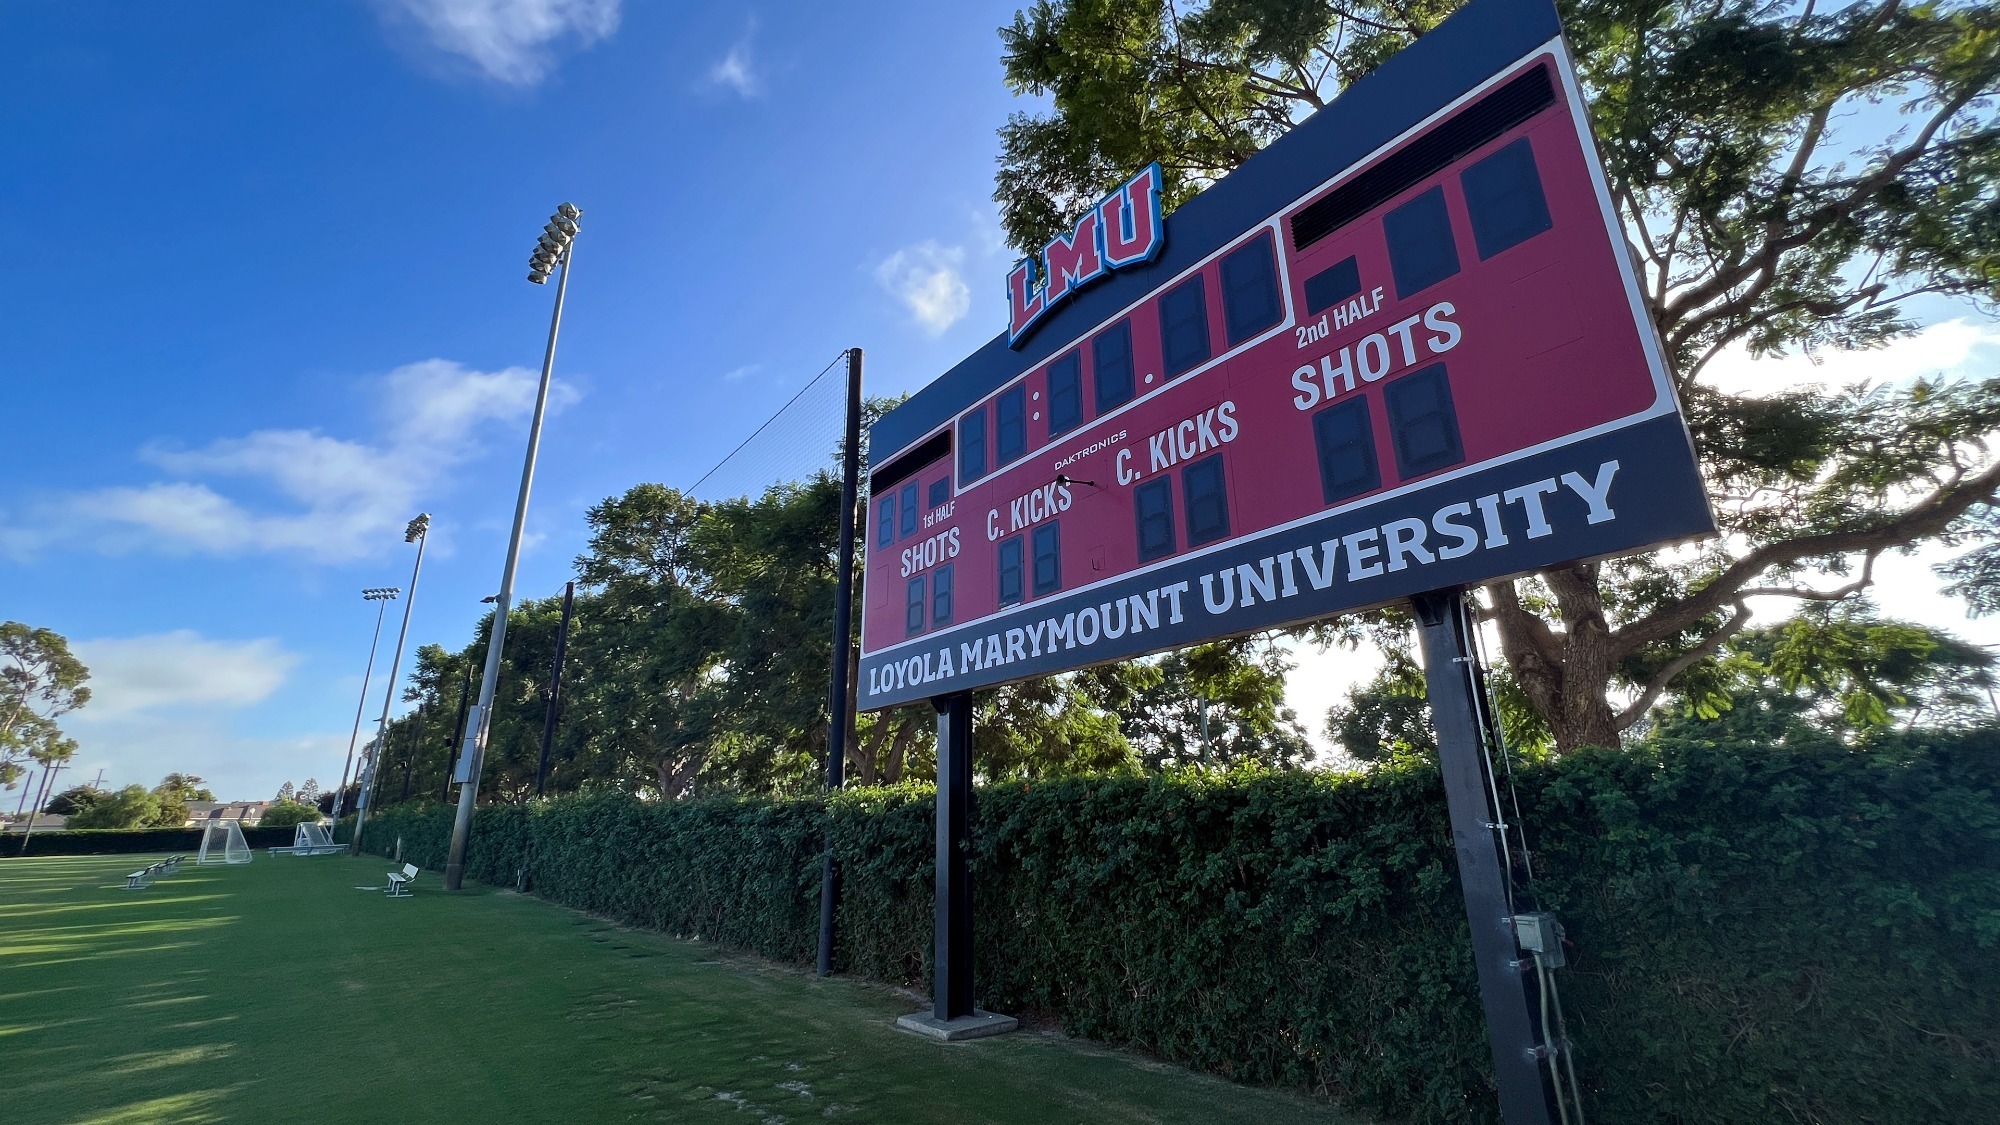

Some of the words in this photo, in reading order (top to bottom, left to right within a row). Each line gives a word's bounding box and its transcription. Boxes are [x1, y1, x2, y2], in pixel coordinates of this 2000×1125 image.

[1006, 161, 1163, 349] LMU
[1295, 314, 1329, 349] 2nd
[1333, 286, 1385, 331] HALF
[1291, 301, 1462, 411] SHOTS
[1054, 429, 1128, 470] DAKTRONICS
[1116, 448, 1141, 486] C.
[1149, 401, 1239, 474] KICKS
[923, 511, 935, 529] 1st
[935, 501, 955, 523] HALF
[987, 509, 1004, 541] C.
[1010, 477, 1072, 532] KICKS
[869, 648, 954, 695] LOYOLA
[960, 581, 1188, 674] MARYMOUNT
[1200, 460, 1620, 615] UNIVERSITY
[901, 526, 960, 577] SHOTS
